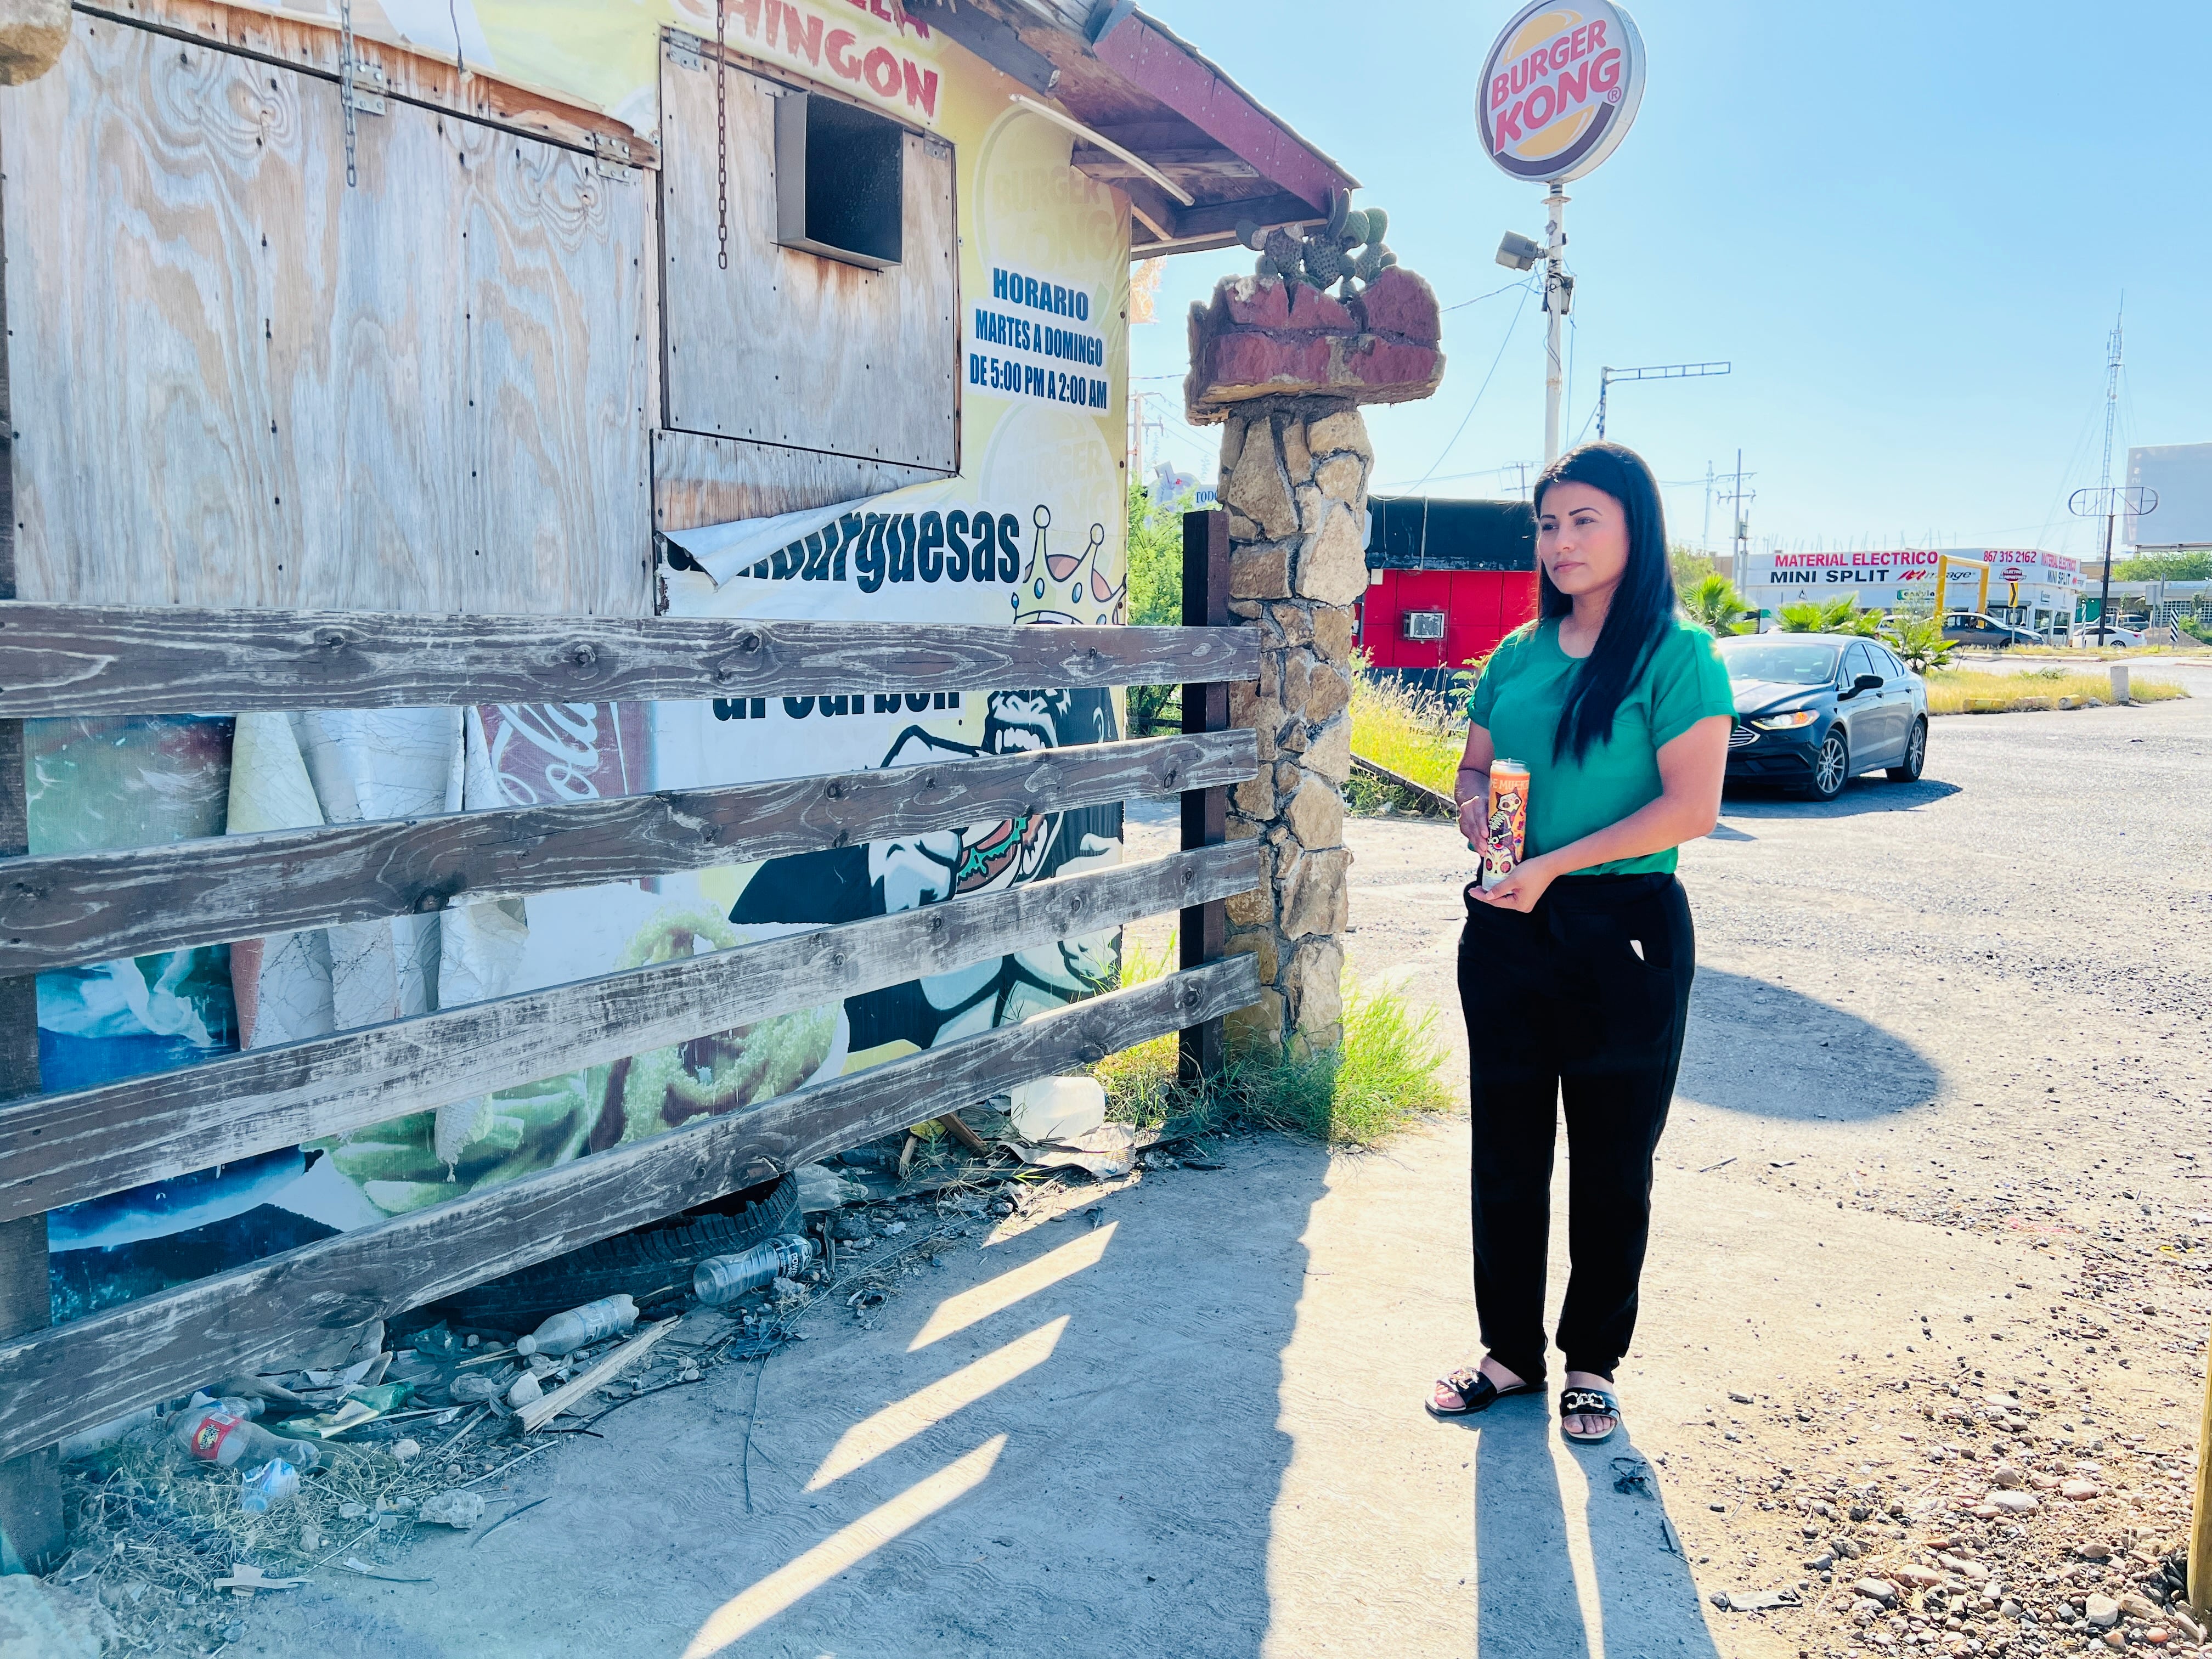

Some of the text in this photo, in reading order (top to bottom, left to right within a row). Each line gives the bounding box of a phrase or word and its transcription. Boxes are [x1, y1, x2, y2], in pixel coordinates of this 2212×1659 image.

[1491, 20, 1606, 111] BURGER
[1495, 48, 1621, 154] KONG
[994, 267, 1088, 321] HORARIO
[975, 308, 1103, 367] MARTES A DOMINGO
[970, 353, 1107, 409] DE 5:00 PM A 2:00 AM
[1770, 569, 1889, 583] MINI SPLIT
[1774, 551, 1938, 567] MATERIAL ELECTRICO
[1983, 551, 2037, 563] 867 315 2162
